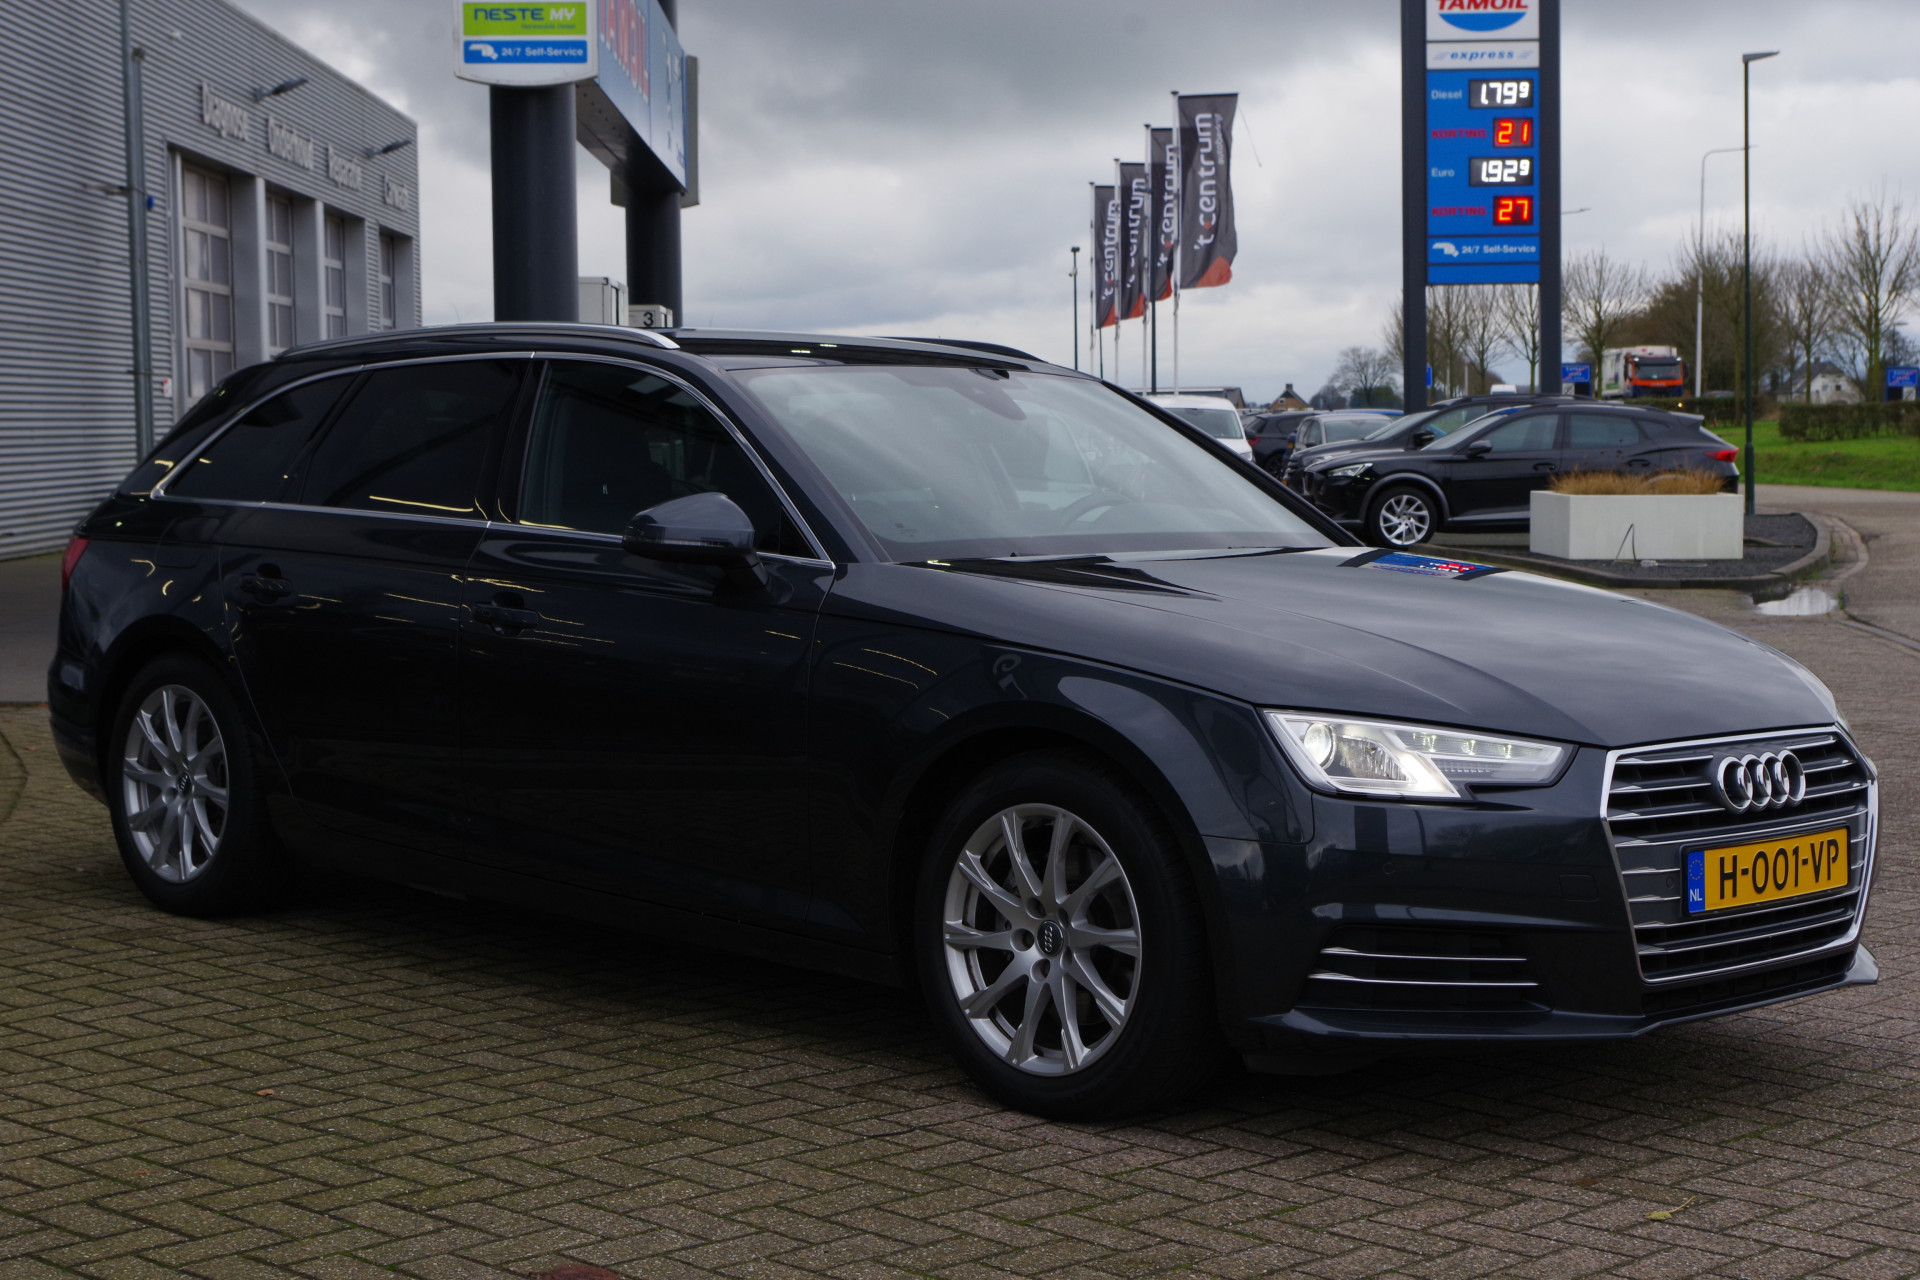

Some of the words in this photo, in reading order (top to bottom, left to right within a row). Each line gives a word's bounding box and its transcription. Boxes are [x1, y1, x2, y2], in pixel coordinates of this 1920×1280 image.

[1438, 0, 1528, 10] TAMOIL
[549, 7, 576, 20] MY
[501, 47, 522, 56] 24/7
[525, 46, 584, 56] Self-Service
[1451, 51, 1514, 61] express
[1431, 89, 1463, 99] Diesel
[1431, 129, 1487, 138] KORTING
[1498, 120, 1530, 144] 21
[1195, 113, 1217, 228] centrum
[1431, 168, 1455, 177] Euro
[1432, 207, 1487, 216] KORTING
[1498, 197, 1529, 221] 27
[1104, 200, 1121, 284] centrum
[1461, 245, 1480, 254] 24/7
[1483, 244, 1536, 254] Self-Service
[602, 277, 609, 286] 3
[643, 311, 654, 327] 3
[1719, 838, 1840, 900] H-001-VP
[1689, 888, 1703, 902] NL
